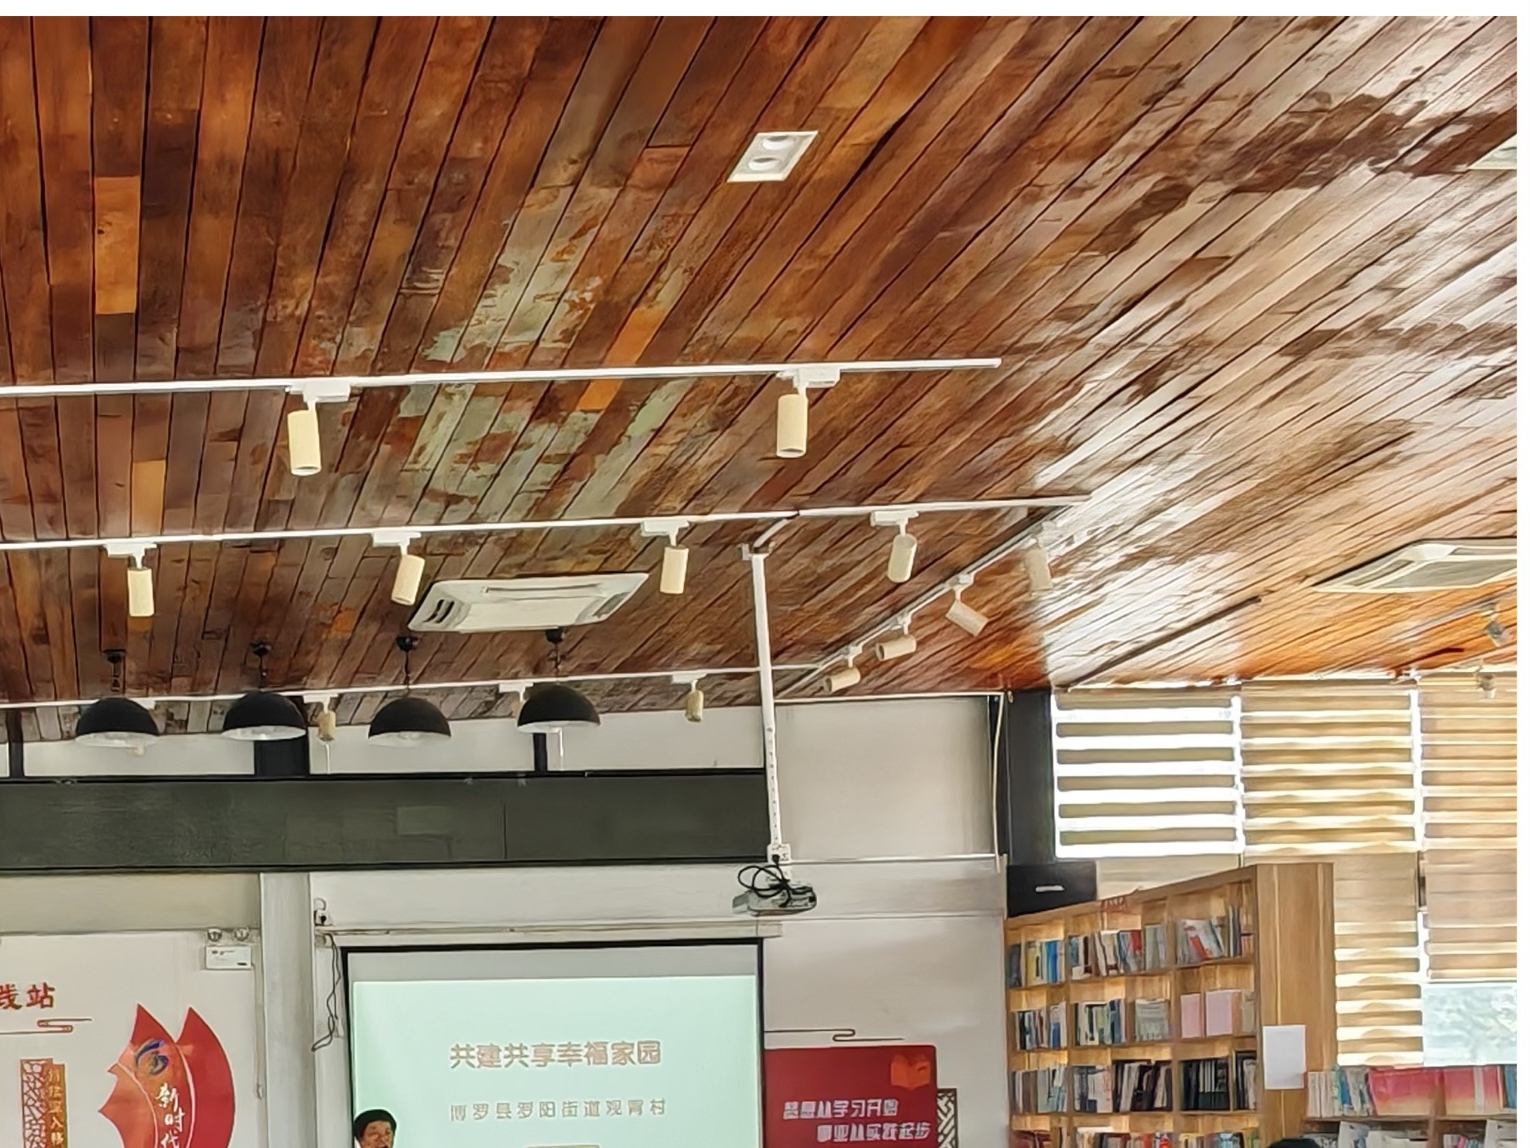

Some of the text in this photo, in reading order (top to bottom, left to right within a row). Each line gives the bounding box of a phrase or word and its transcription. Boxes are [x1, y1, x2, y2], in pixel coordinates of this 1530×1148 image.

[449, 1040, 661, 1069] 共建共享幸福家园
